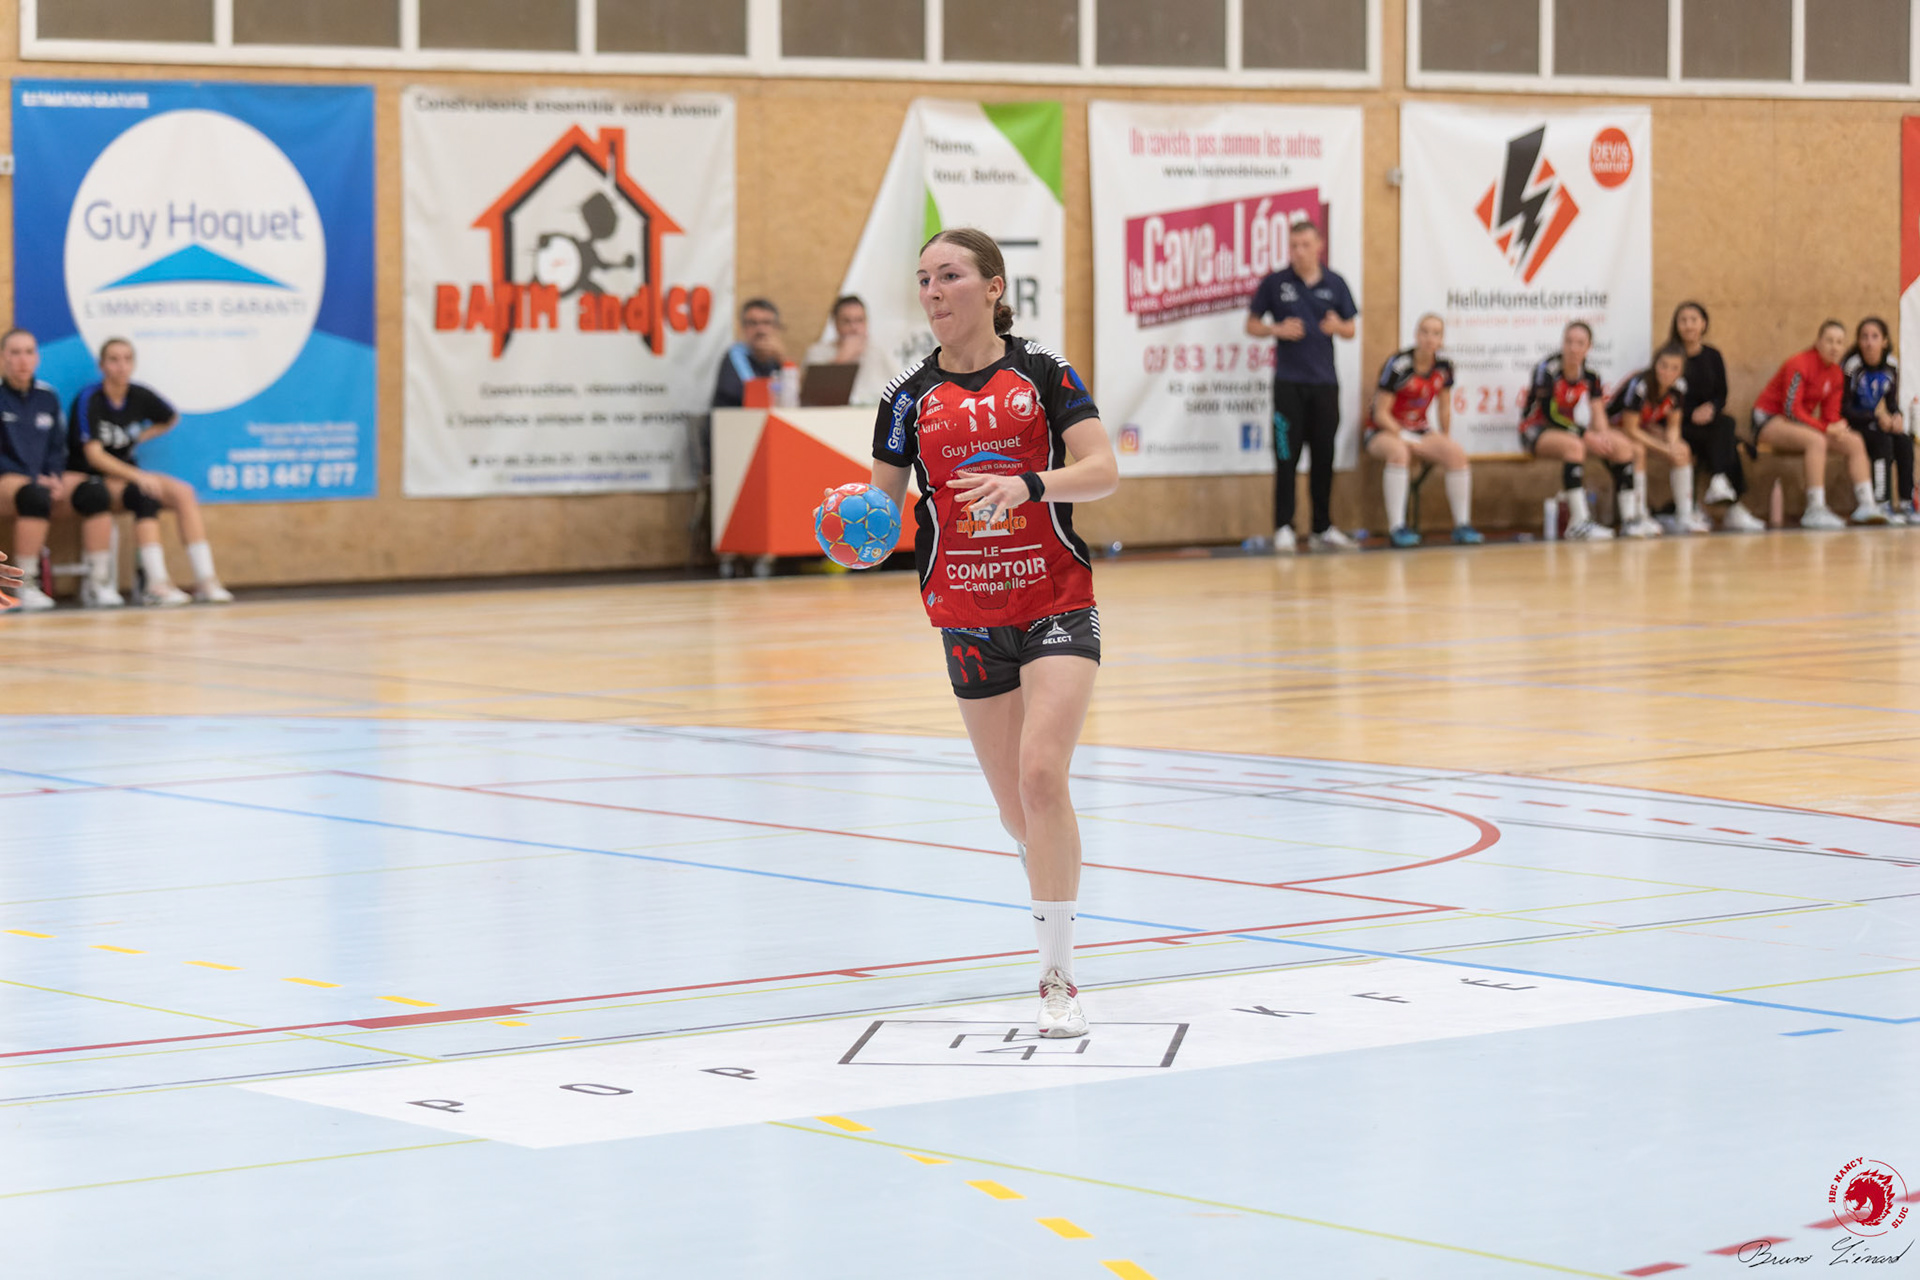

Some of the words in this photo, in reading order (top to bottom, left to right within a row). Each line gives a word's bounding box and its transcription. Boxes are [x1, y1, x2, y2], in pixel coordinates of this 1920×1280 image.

[1593, 141, 1629, 161] DEVIS
[83, 201, 157, 249] Guy
[168, 201, 305, 248] Hoquet
[1143, 216, 1216, 295] Cave
[577, 285, 650, 334] and
[1447, 290, 1608, 310] HelloHomeLorraine
[1173, 344, 1205, 372] 83
[1214, 344, 1241, 372] 17
[1453, 386, 1467, 414] 6
[1477, 386, 1504, 414] 21
[959, 395, 997, 432] 11
[942, 442, 967, 458] Guy
[970, 436, 1021, 452] Hoquet
[984, 546, 999, 557] LE
[946, 557, 1047, 580] COMPTOIR
[963, 577, 1027, 595] Campanile
[1042, 635, 1072, 645] SELECT
[952, 645, 988, 683] 11
